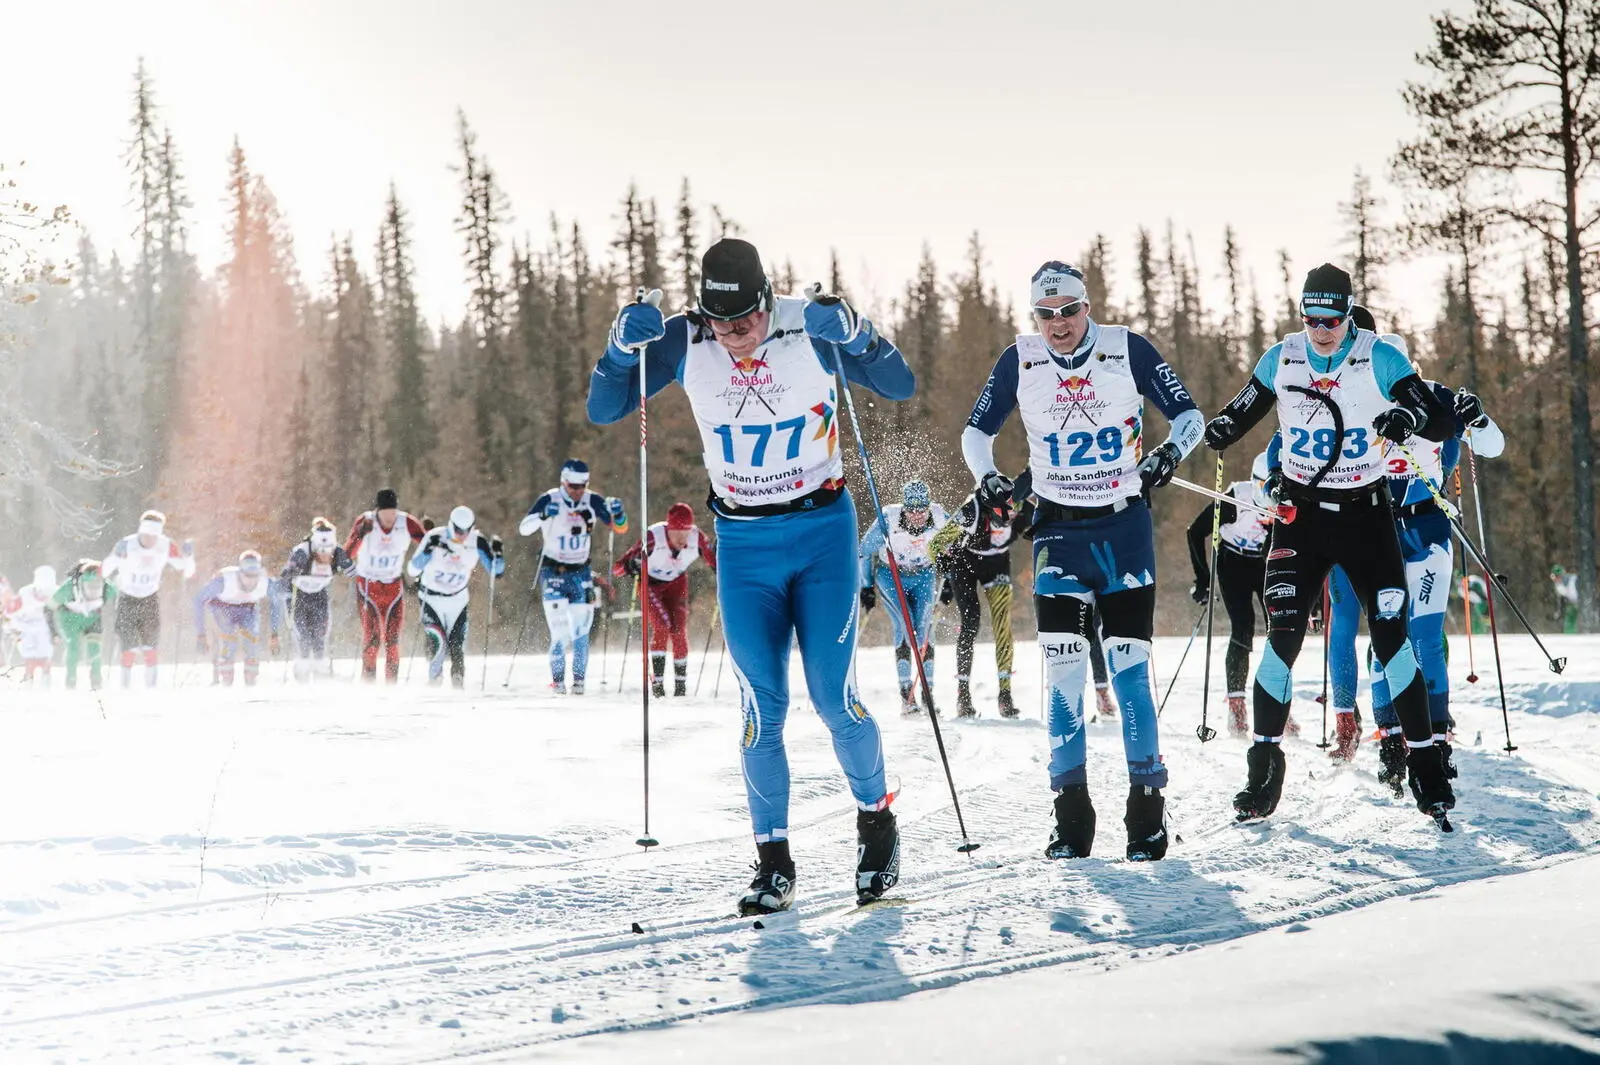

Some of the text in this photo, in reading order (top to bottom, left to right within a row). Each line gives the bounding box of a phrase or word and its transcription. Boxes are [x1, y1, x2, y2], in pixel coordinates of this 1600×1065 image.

[713, 415, 807, 468] 177
[1043, 426, 1123, 467] 129
[1289, 427, 1369, 461] 283
[723, 466, 804, 485] Johan Furunäs
[1046, 467, 1122, 481] Johan Sandberg
[1288, 458, 1316, 472] Fredrik
[1069, 493, 1094, 501] March
[1095, 491, 1114, 501] 2019
[1126, 700, 1138, 742] PELAGIA
